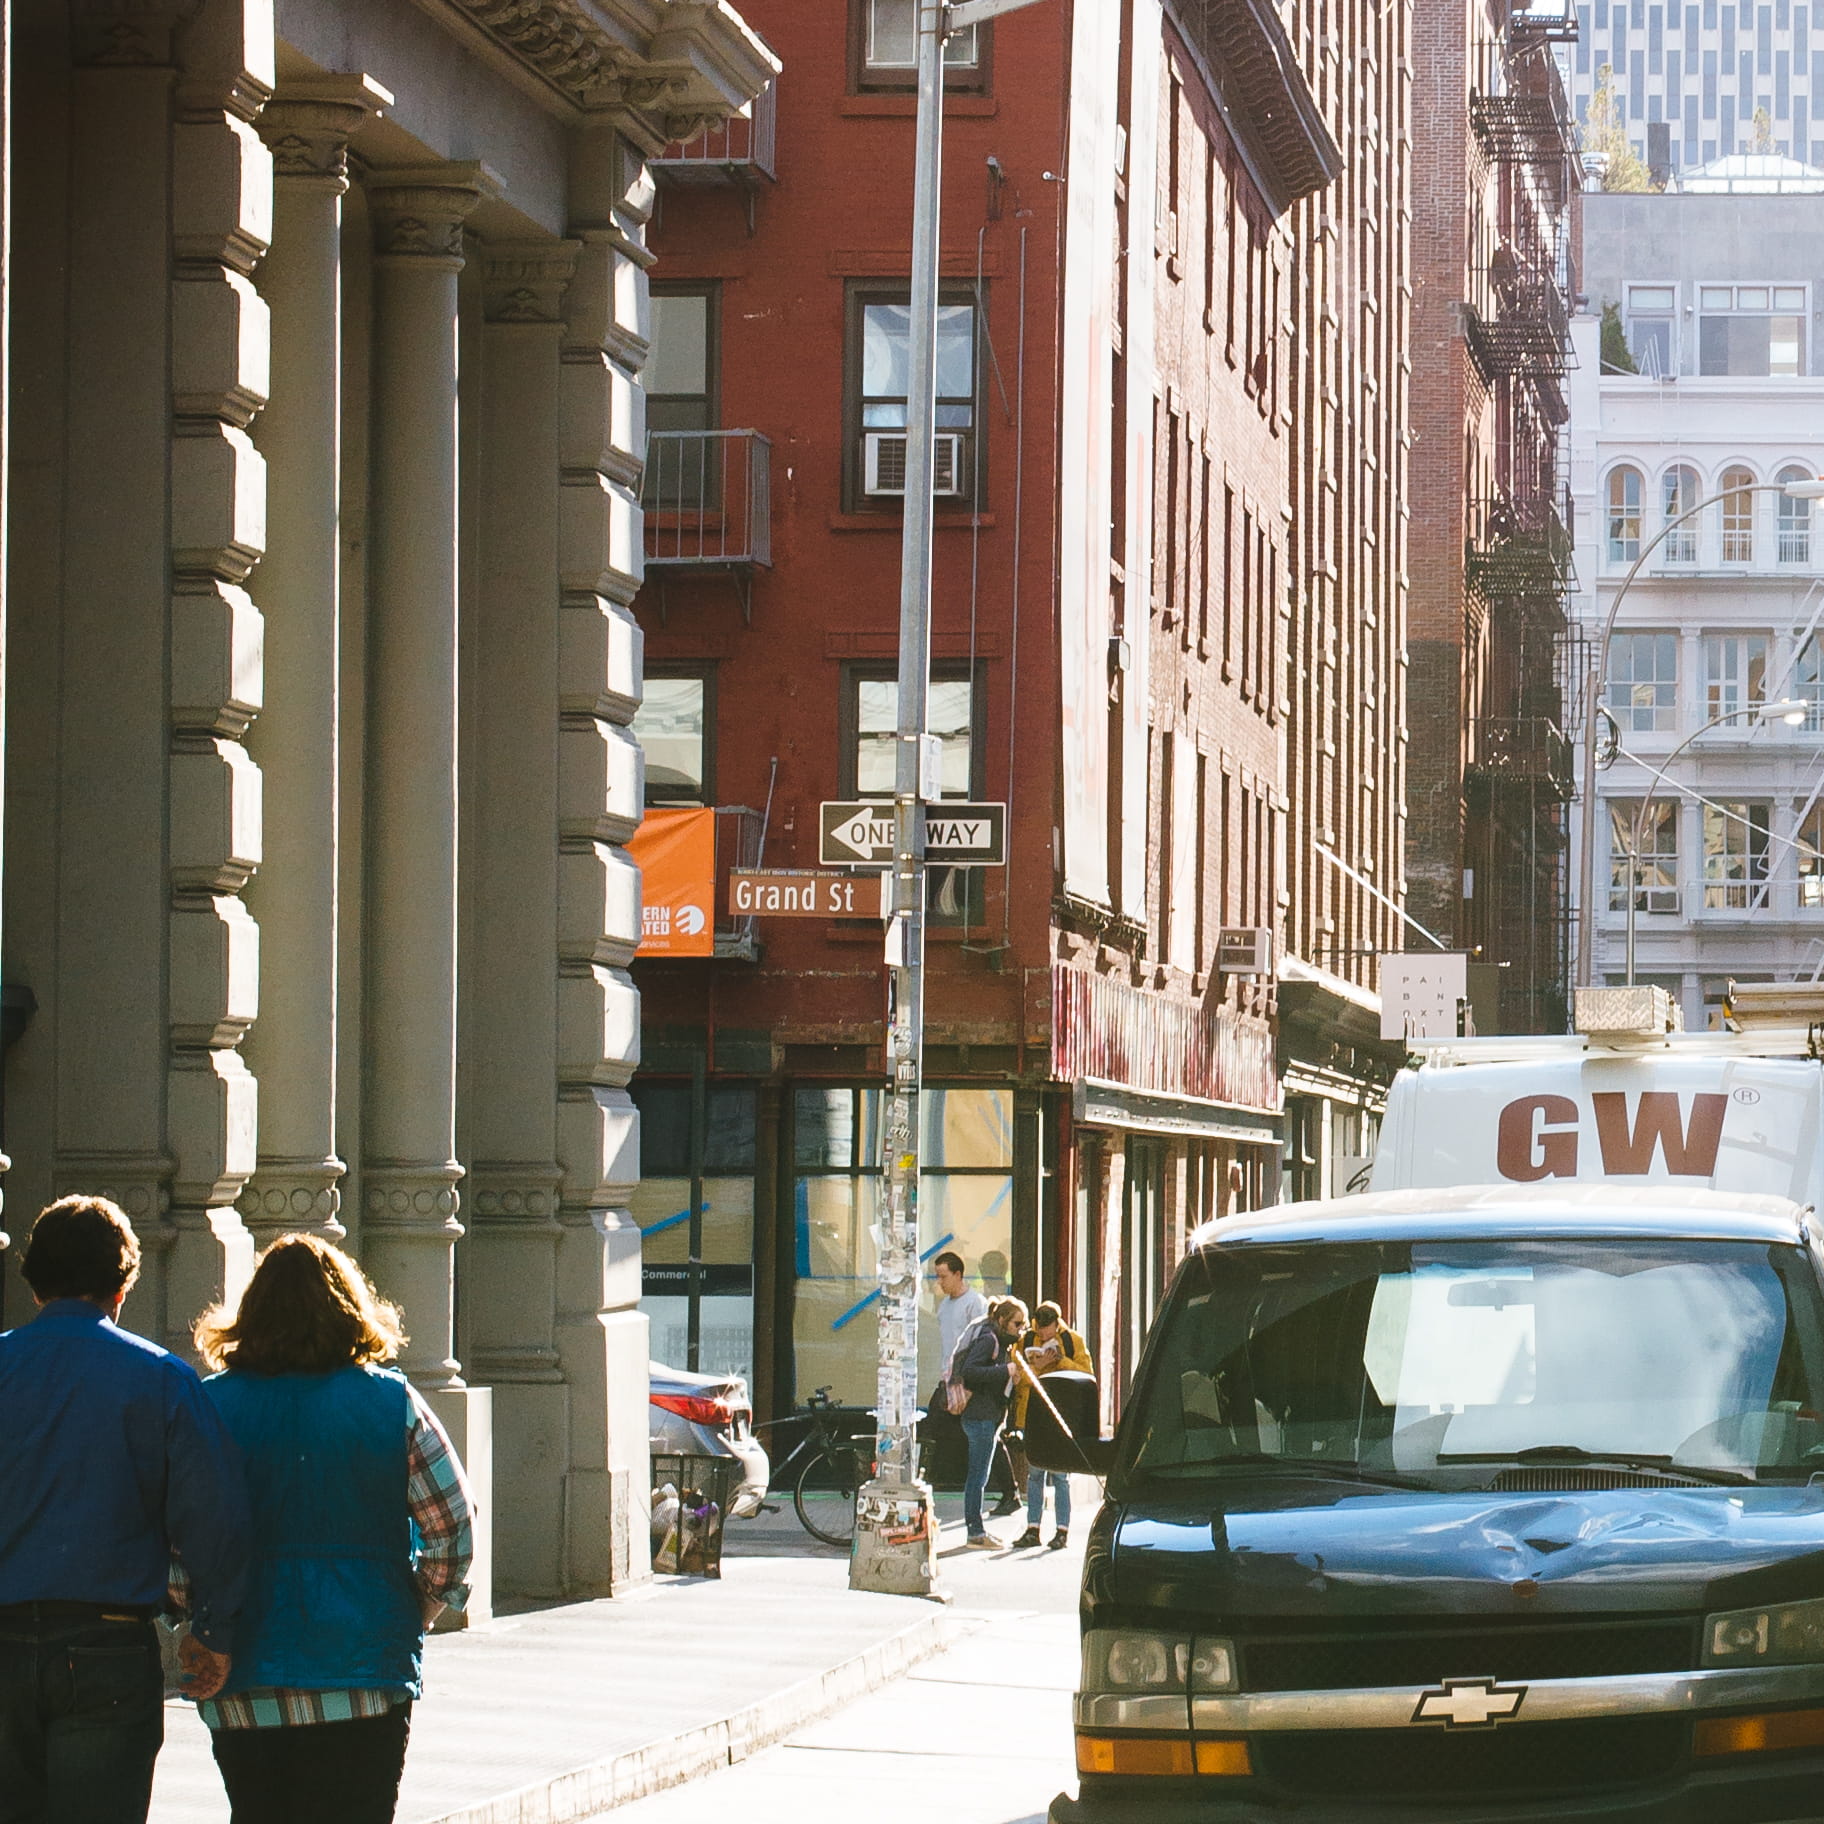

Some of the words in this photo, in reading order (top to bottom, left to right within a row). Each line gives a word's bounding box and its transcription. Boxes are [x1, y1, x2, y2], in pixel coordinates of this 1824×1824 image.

[926, 823, 979, 845] WAY
[736, 880, 816, 910] Grand
[829, 882, 854, 912] St
[1497, 1092, 1729, 1182] GW
